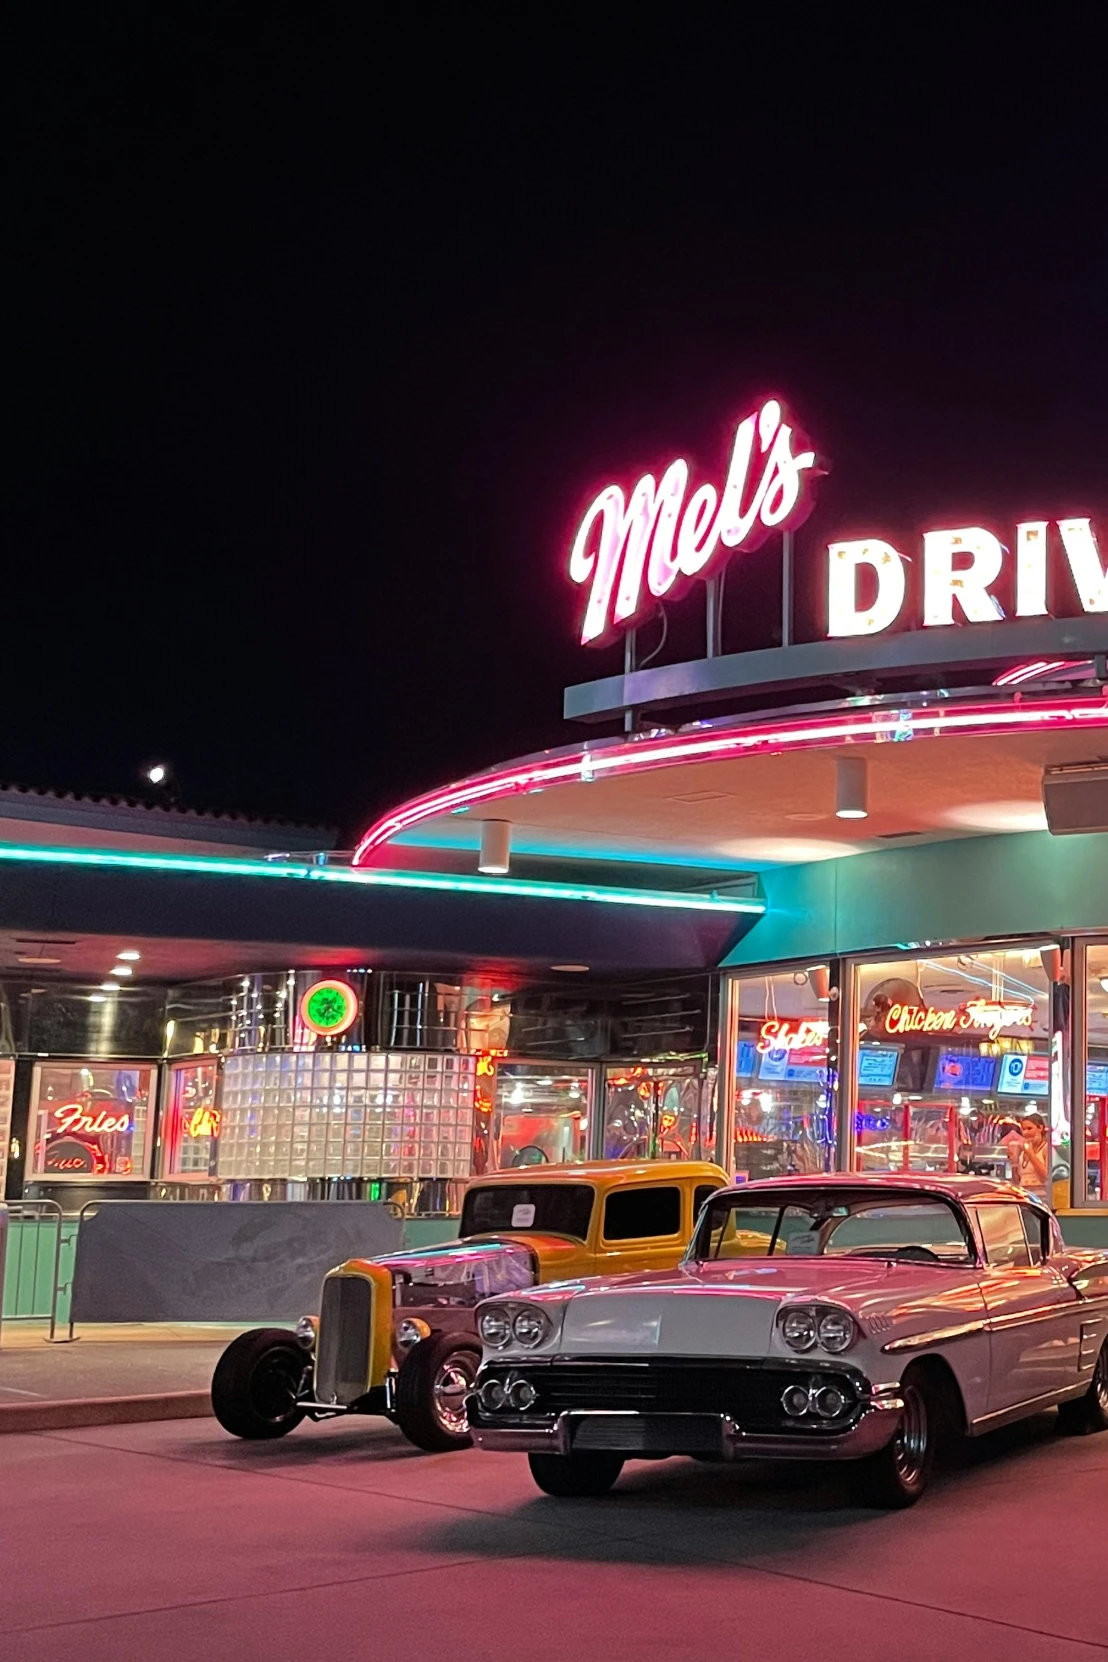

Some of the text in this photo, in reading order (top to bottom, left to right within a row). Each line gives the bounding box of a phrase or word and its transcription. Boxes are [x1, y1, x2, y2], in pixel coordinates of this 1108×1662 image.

[569, 399, 815, 646] Mel's
[885, 1004, 957, 1034] Chicken
[54, 1103, 131, 1134] Fries
